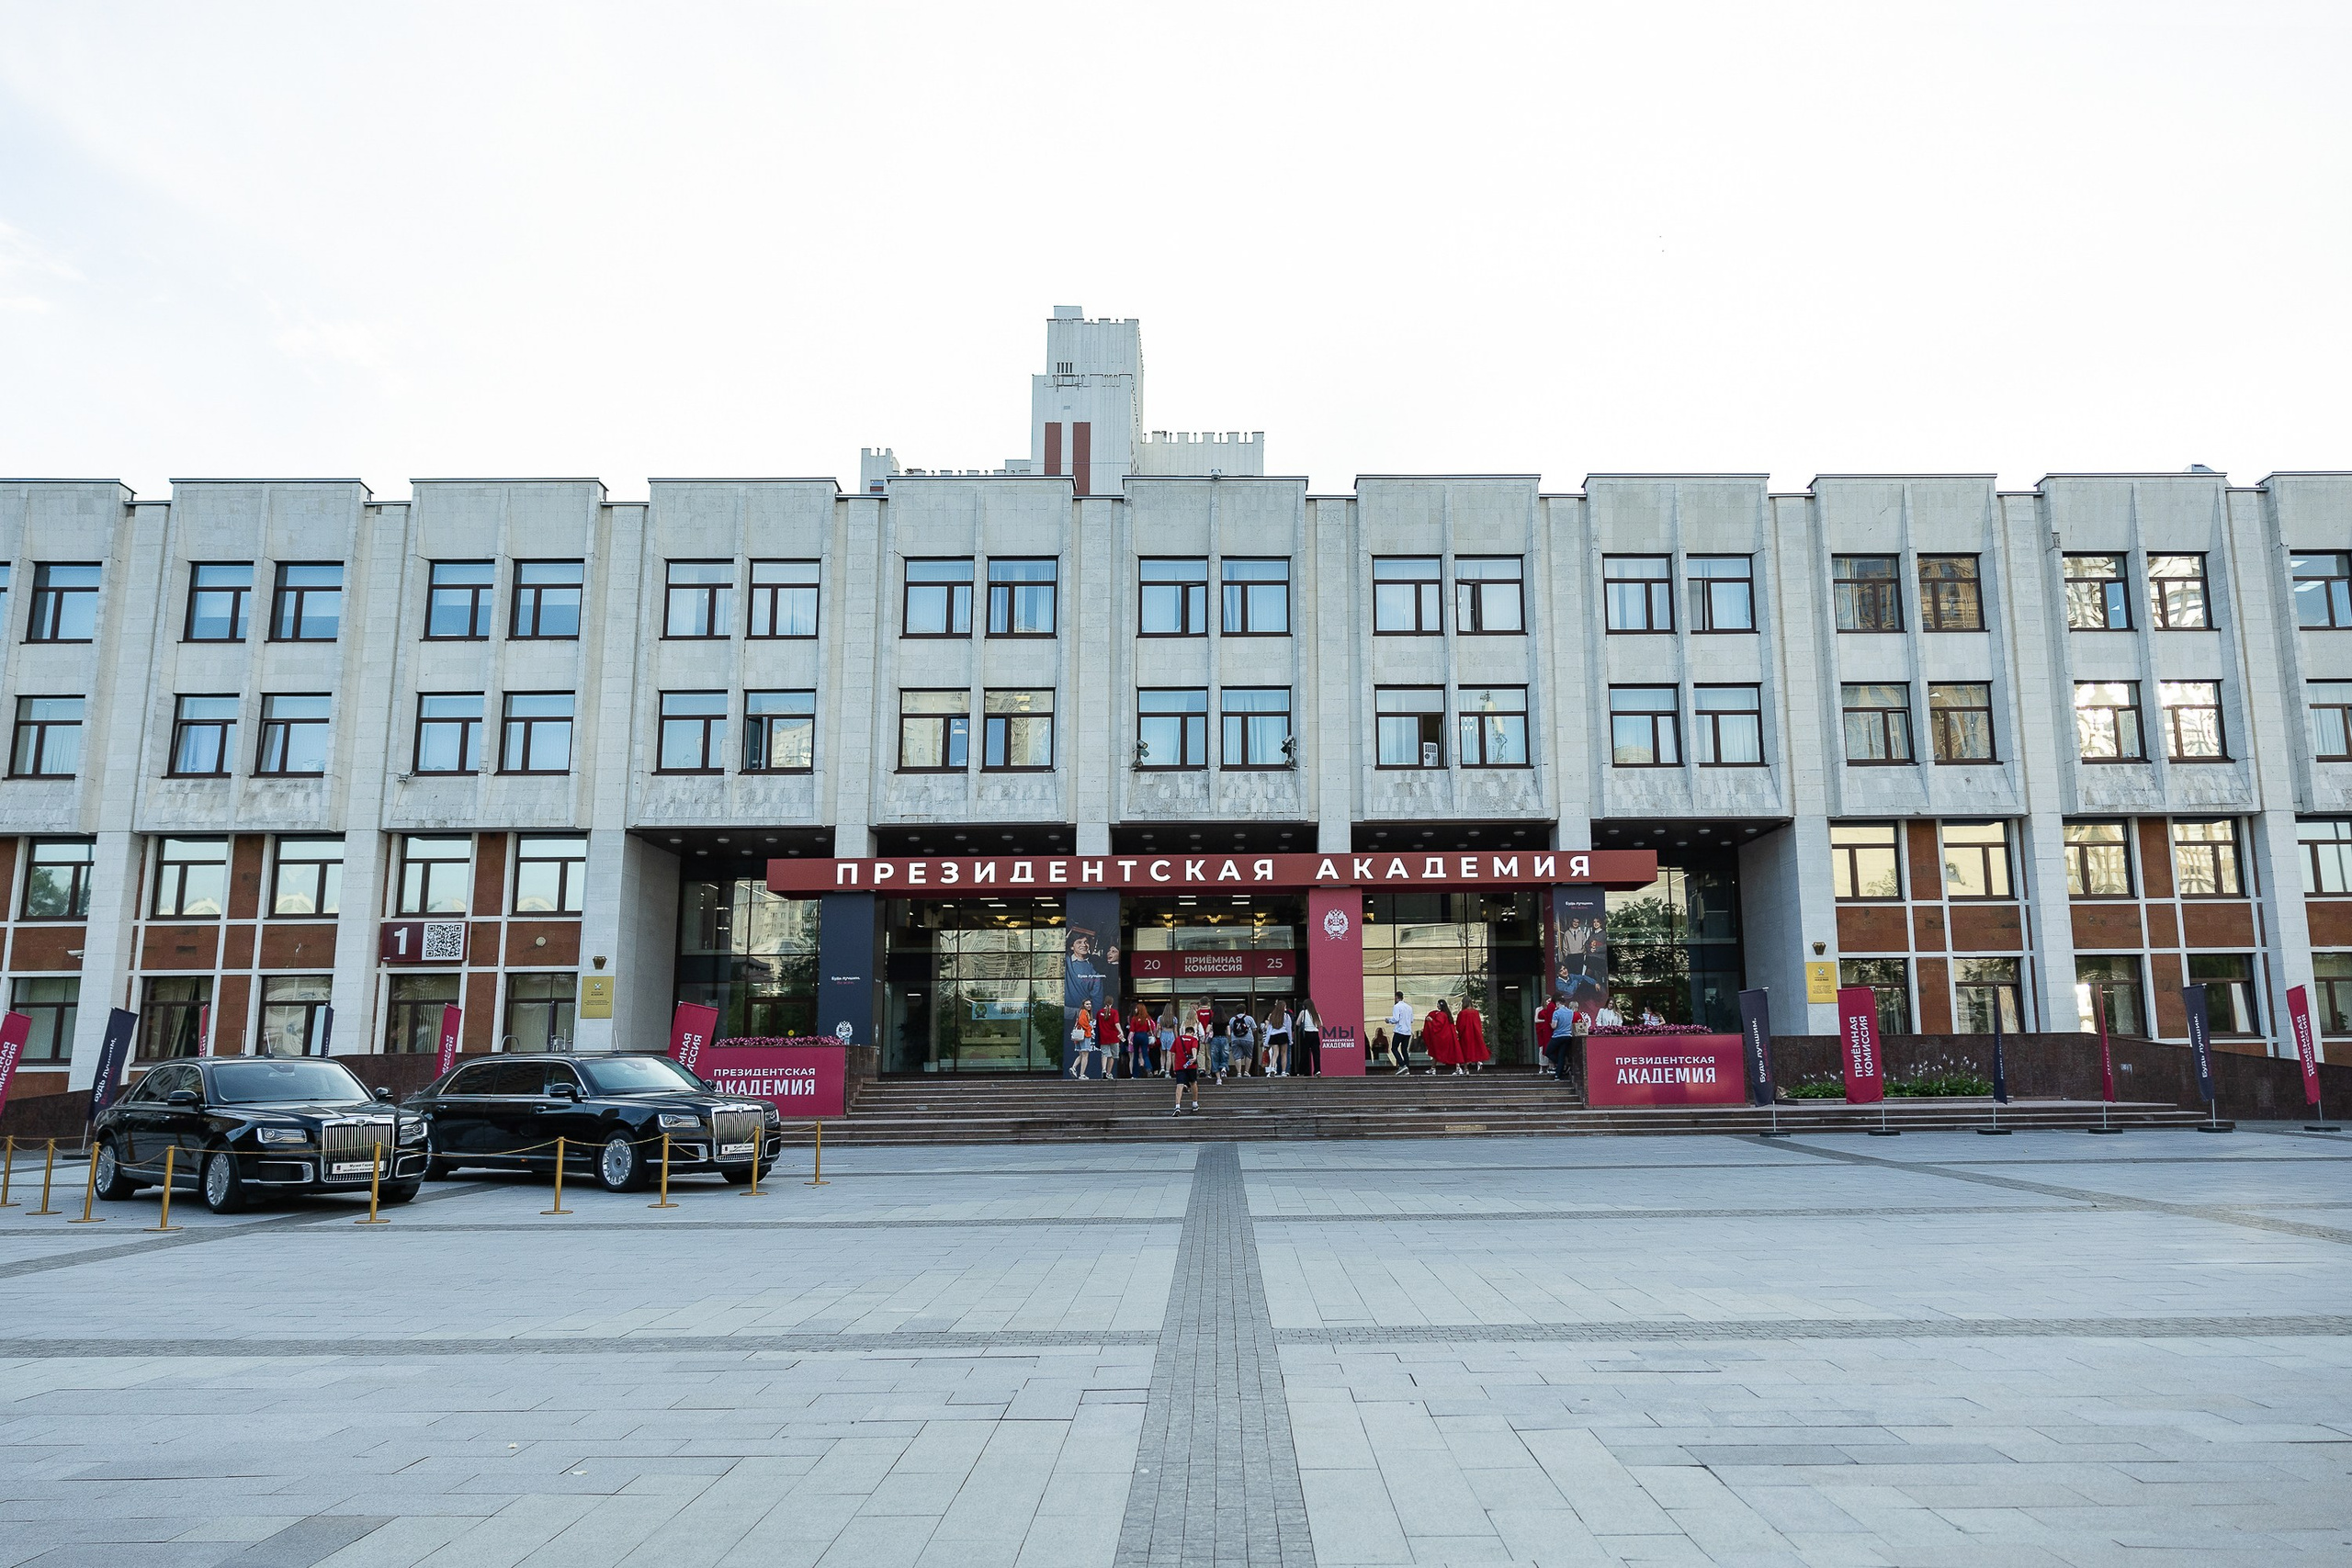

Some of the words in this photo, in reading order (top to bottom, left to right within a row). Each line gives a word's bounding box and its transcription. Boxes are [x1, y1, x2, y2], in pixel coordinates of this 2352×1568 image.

[836, 859, 1273, 885] ПРЕЗИДЕНТСКАЯ
[1315, 855, 1589, 880] АКАДЕМИЯ
[394, 927, 408, 955] 1
[1144, 959, 1161, 970] 20
[1184, 954, 1242, 964] ПРИЁМНАЯ
[1184, 964, 1243, 973] КОМИССИЯ
[1266, 957, 1283, 969] 25
[1321, 1025, 1354, 1039] МЫ
[1751, 1018, 1763, 1058] лучшим.
[2193, 1013, 2205, 1054] лучшим.
[678, 1032, 693, 1065] МНАЯ
[686, 1034, 703, 1071] ИССИЯ
[1849, 1016, 1863, 1077] ПРИЁМНАЯ
[1859, 1015, 1874, 1077] КОМИССИЯ
[0, 1043, 17, 1094] МИССИЯ
[713, 1067, 816, 1077] ПРЕЗИДЕНТСКАЯ
[1615, 1056, 1715, 1065] ПРЕЗИДЕНТСКАЯ
[1758, 1060, 1767, 1083] Будь
[1617, 1066, 1716, 1084] АКАДЕМИЯ
[715, 1078, 816, 1096] АКАДЕМИЯ
